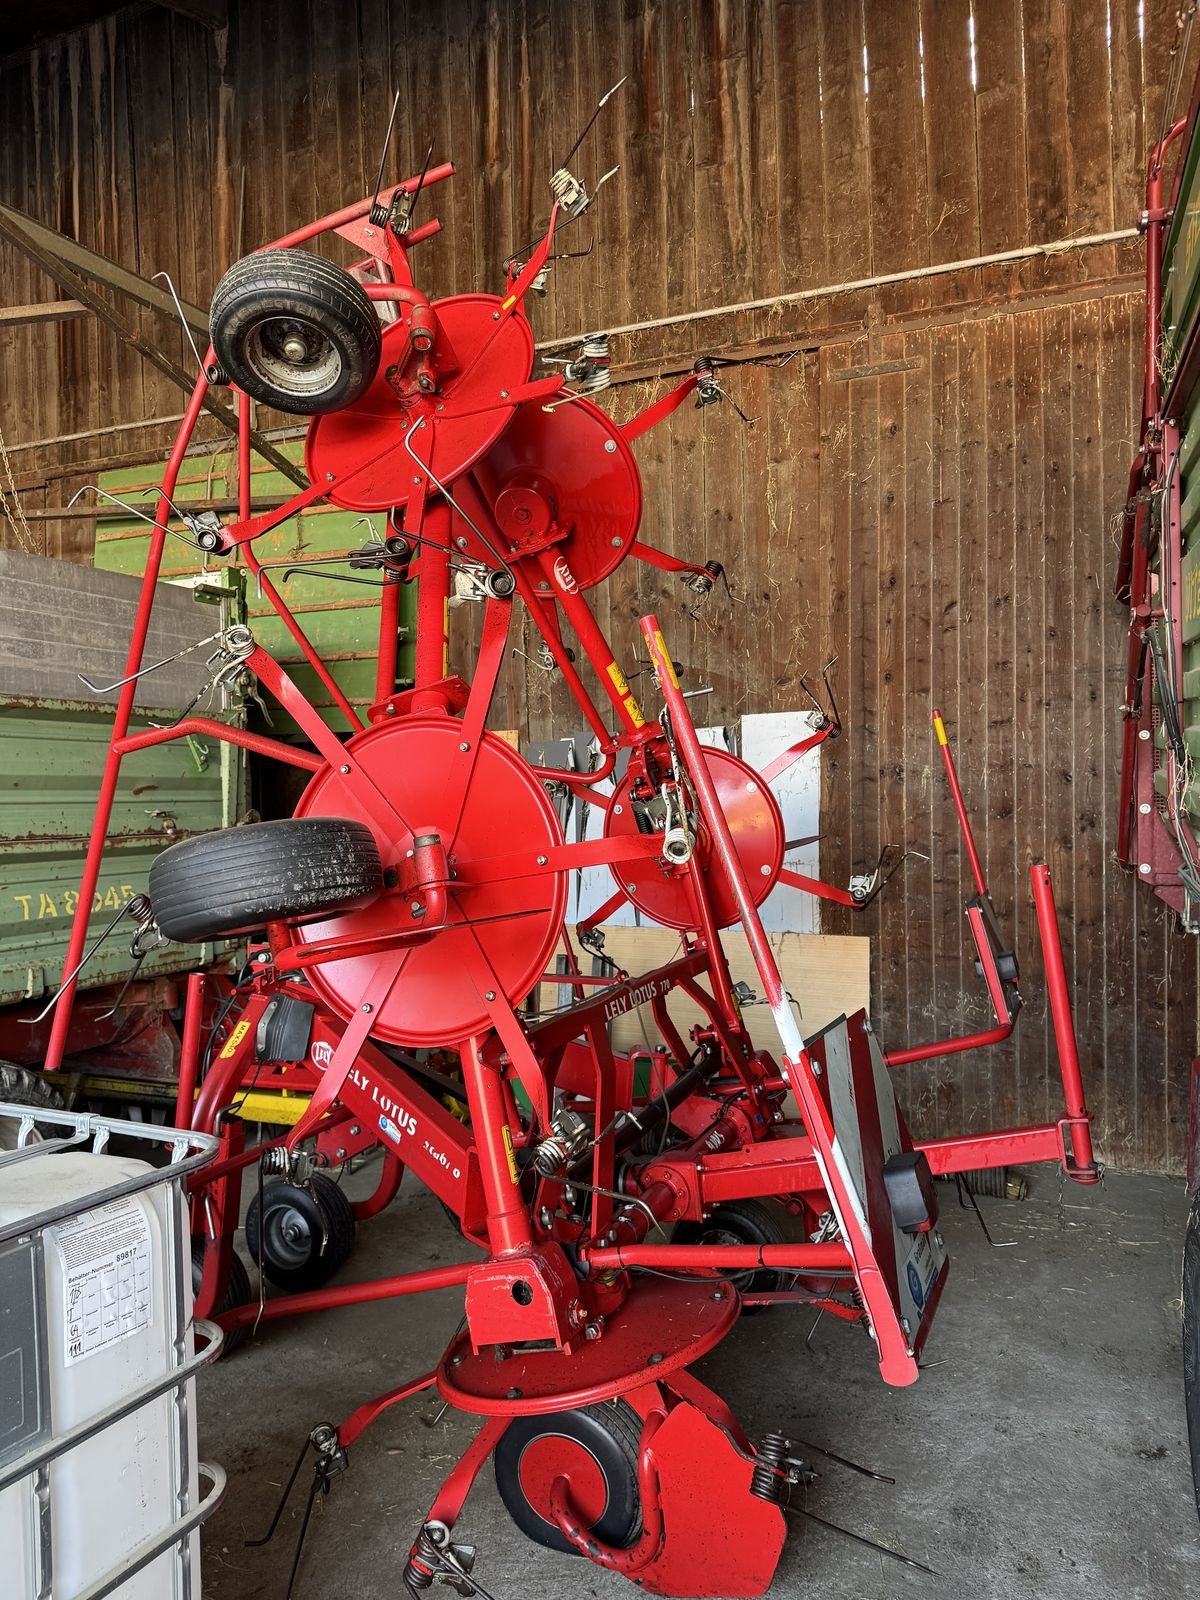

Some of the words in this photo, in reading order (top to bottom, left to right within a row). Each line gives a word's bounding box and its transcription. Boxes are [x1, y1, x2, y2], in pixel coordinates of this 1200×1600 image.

[556, 564, 577, 592] LELY
[14, 893, 58, 920] TA
[604, 995, 627, 1020] LELY
[629, 981, 657, 1006] LOTUS
[660, 978, 671, 993] 770
[314, 1042, 332, 1065] LELY
[371, 1087, 417, 1136] LOTUS
[68, 1261, 114, 1284] Behälter-Nummer
[116, 1247, 137, 1263] 89817
